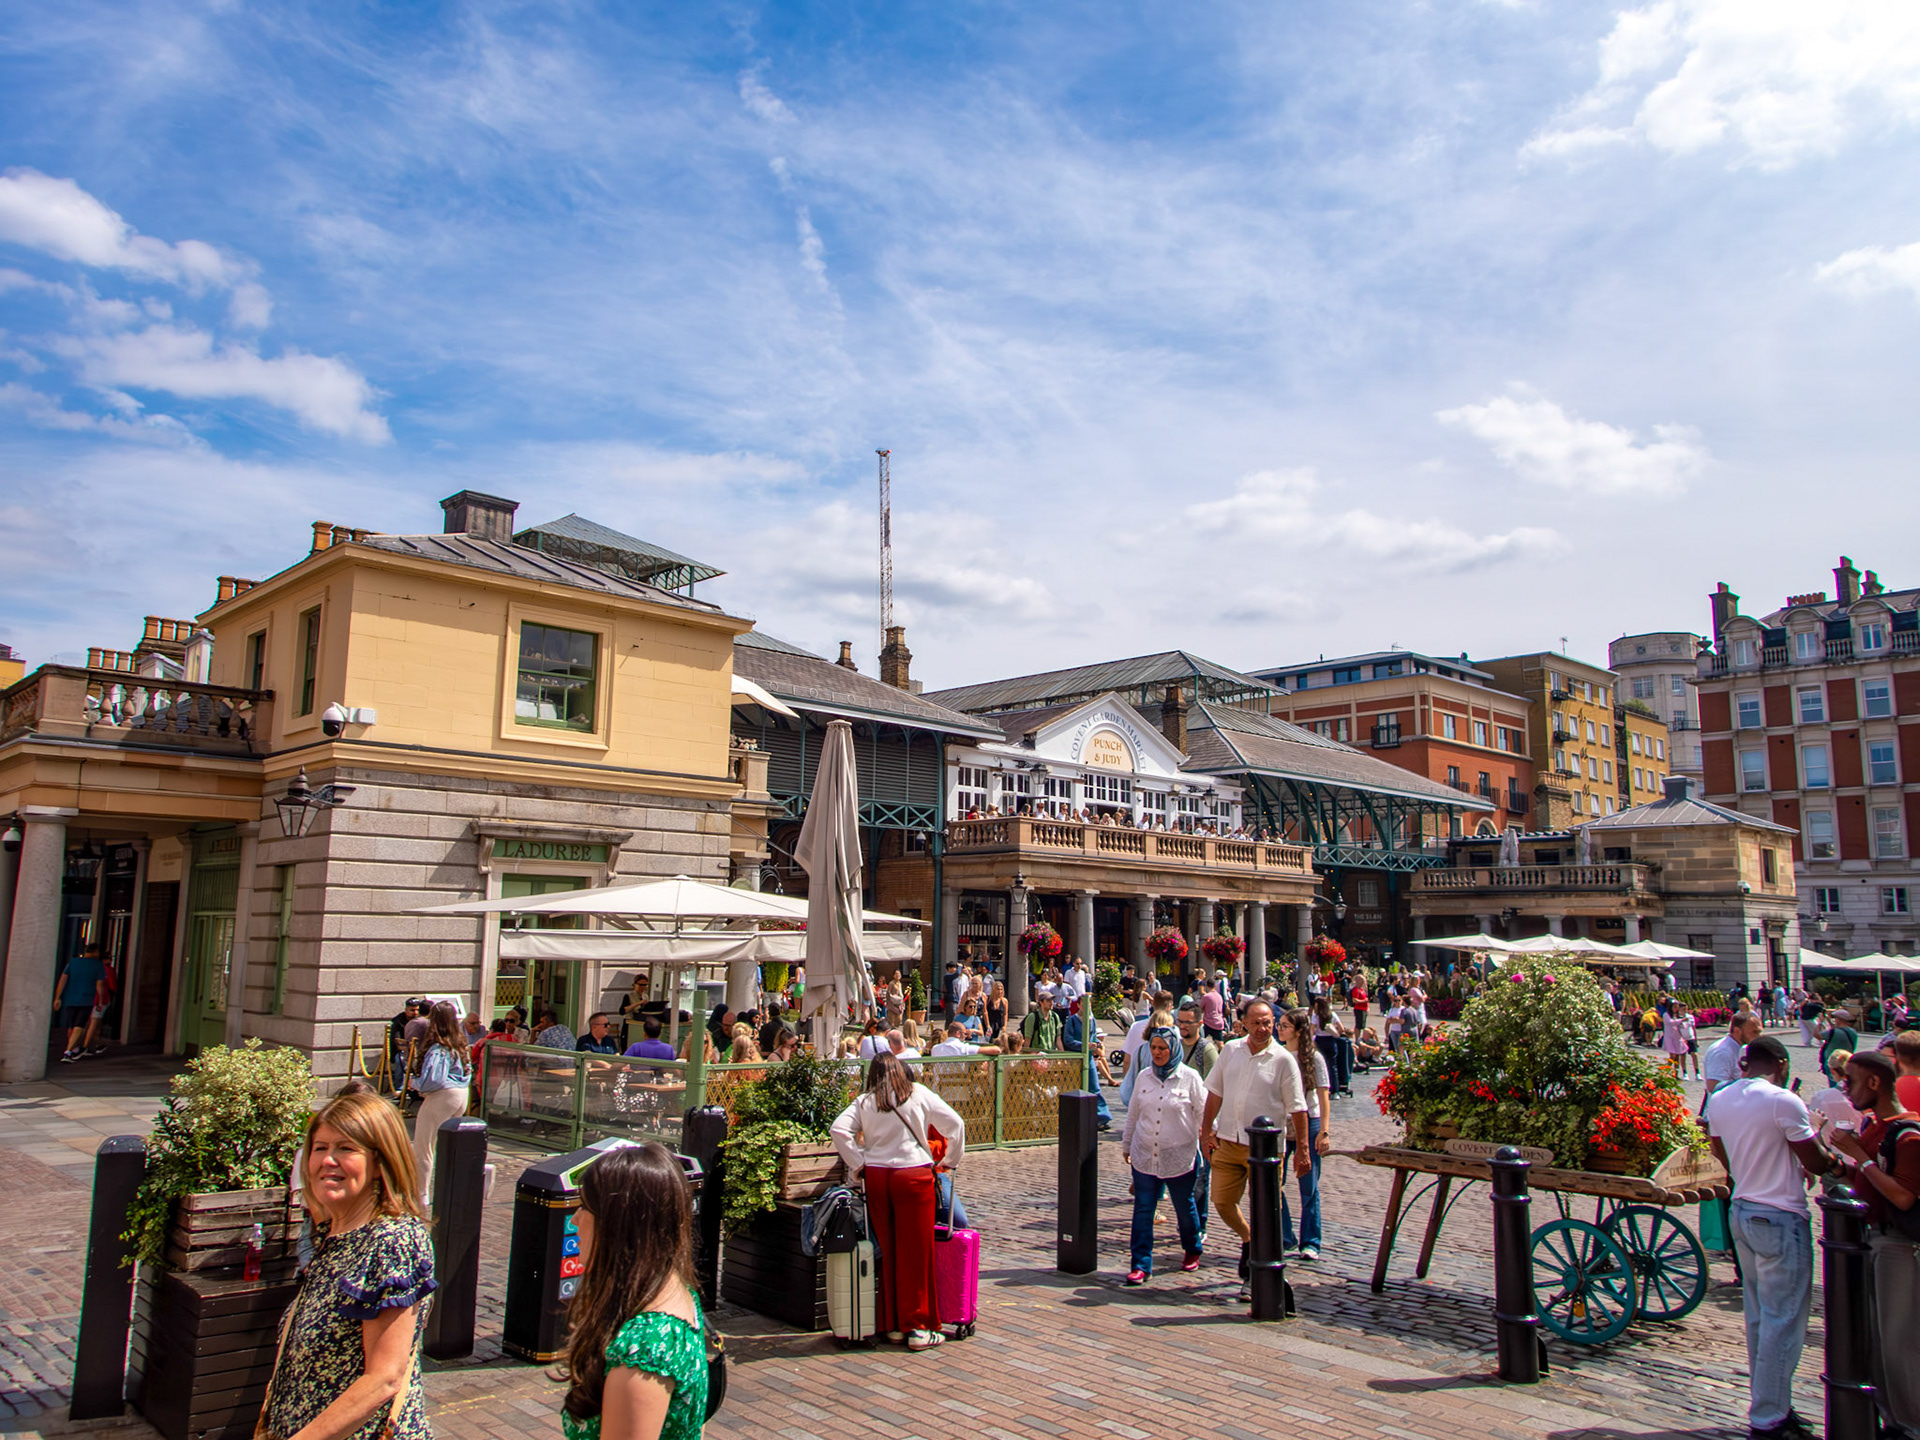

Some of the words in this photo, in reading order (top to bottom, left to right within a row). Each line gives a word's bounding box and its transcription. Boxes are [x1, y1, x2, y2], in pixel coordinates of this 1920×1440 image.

[1070, 716, 1092, 760] COVENT
[1092, 712, 1127, 729] GARDEN
[1094, 738, 1122, 752] PUNCH
[1094, 753, 1100, 762] &
[1101, 753, 1122, 765] JUDY
[1452, 1143, 1493, 1155] COVENT
